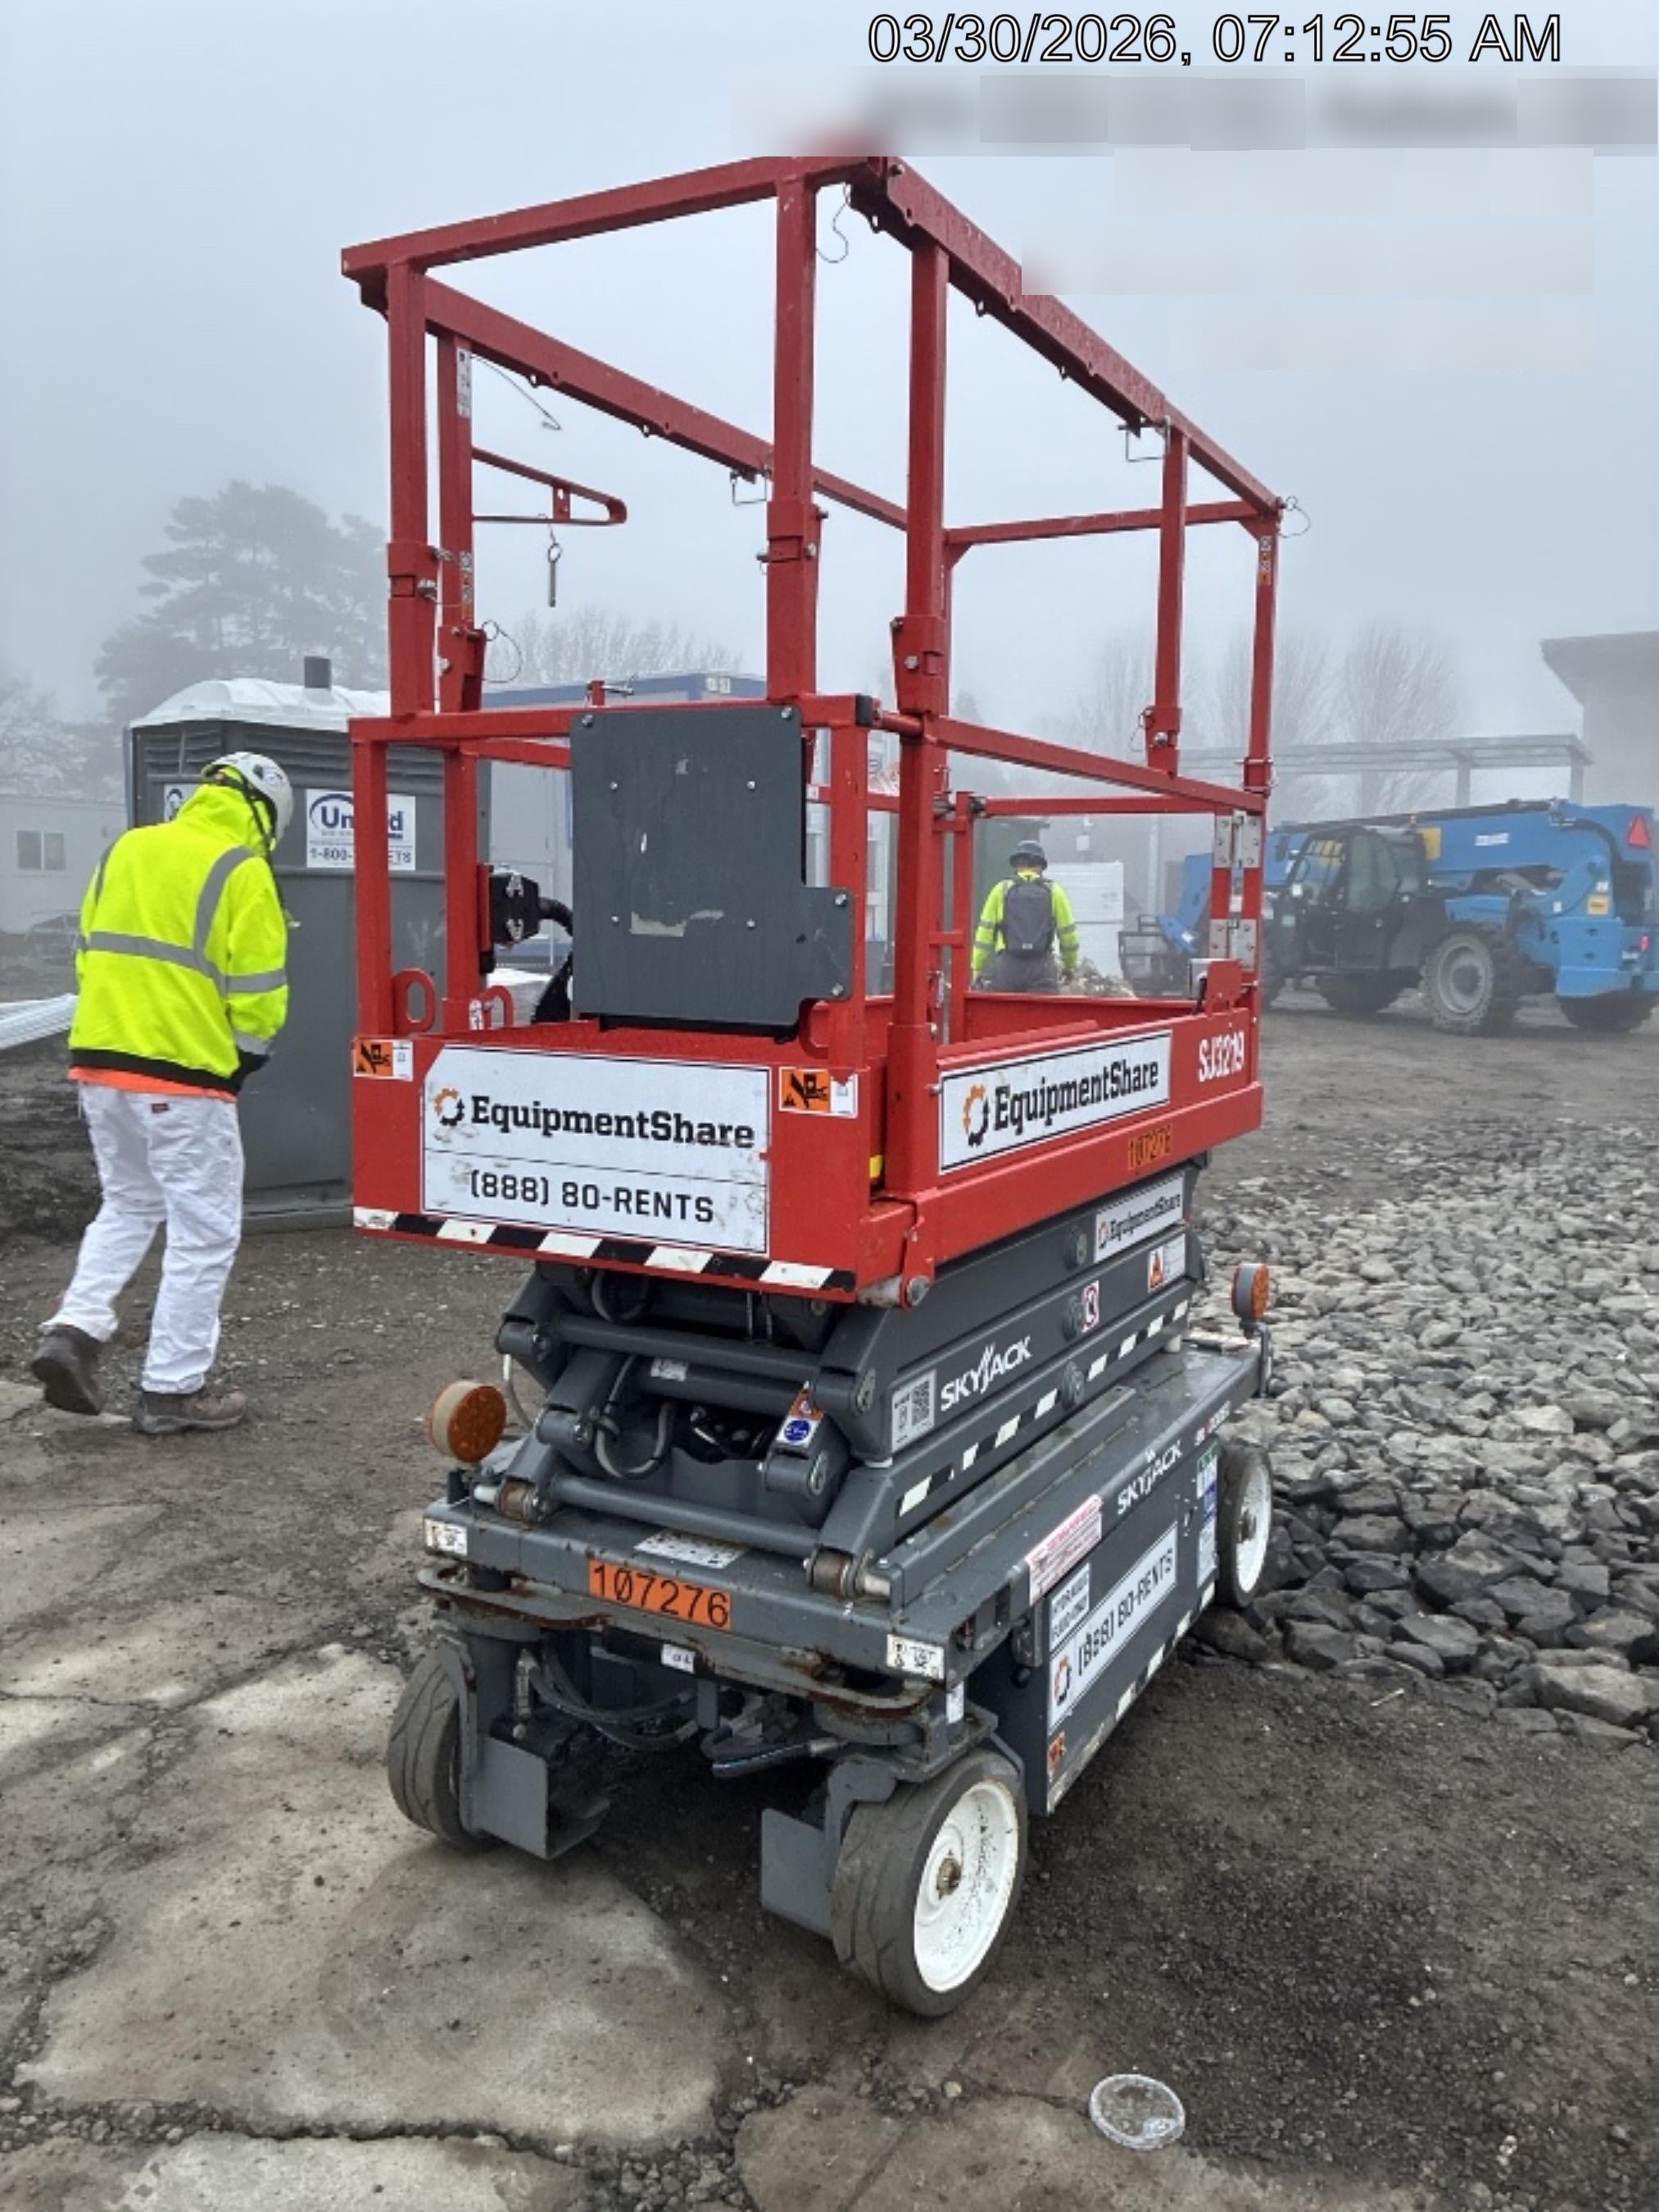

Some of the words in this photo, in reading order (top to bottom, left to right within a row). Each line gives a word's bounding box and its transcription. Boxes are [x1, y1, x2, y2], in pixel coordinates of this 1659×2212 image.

[1199, 1031, 1244, 1082] SJ3219
[471, 1095, 755, 1149] EquipmentShare
[994, 1058, 1159, 1135] EquipmentShare
[470, 1170, 550, 1207] (888)
[562, 1181, 714, 1223] 80-RENTS
[1109, 1194, 1181, 1242] EquipmentShare
[941, 1335, 1032, 1412] SKYJACK
[594, 1563, 728, 1628] 107276
